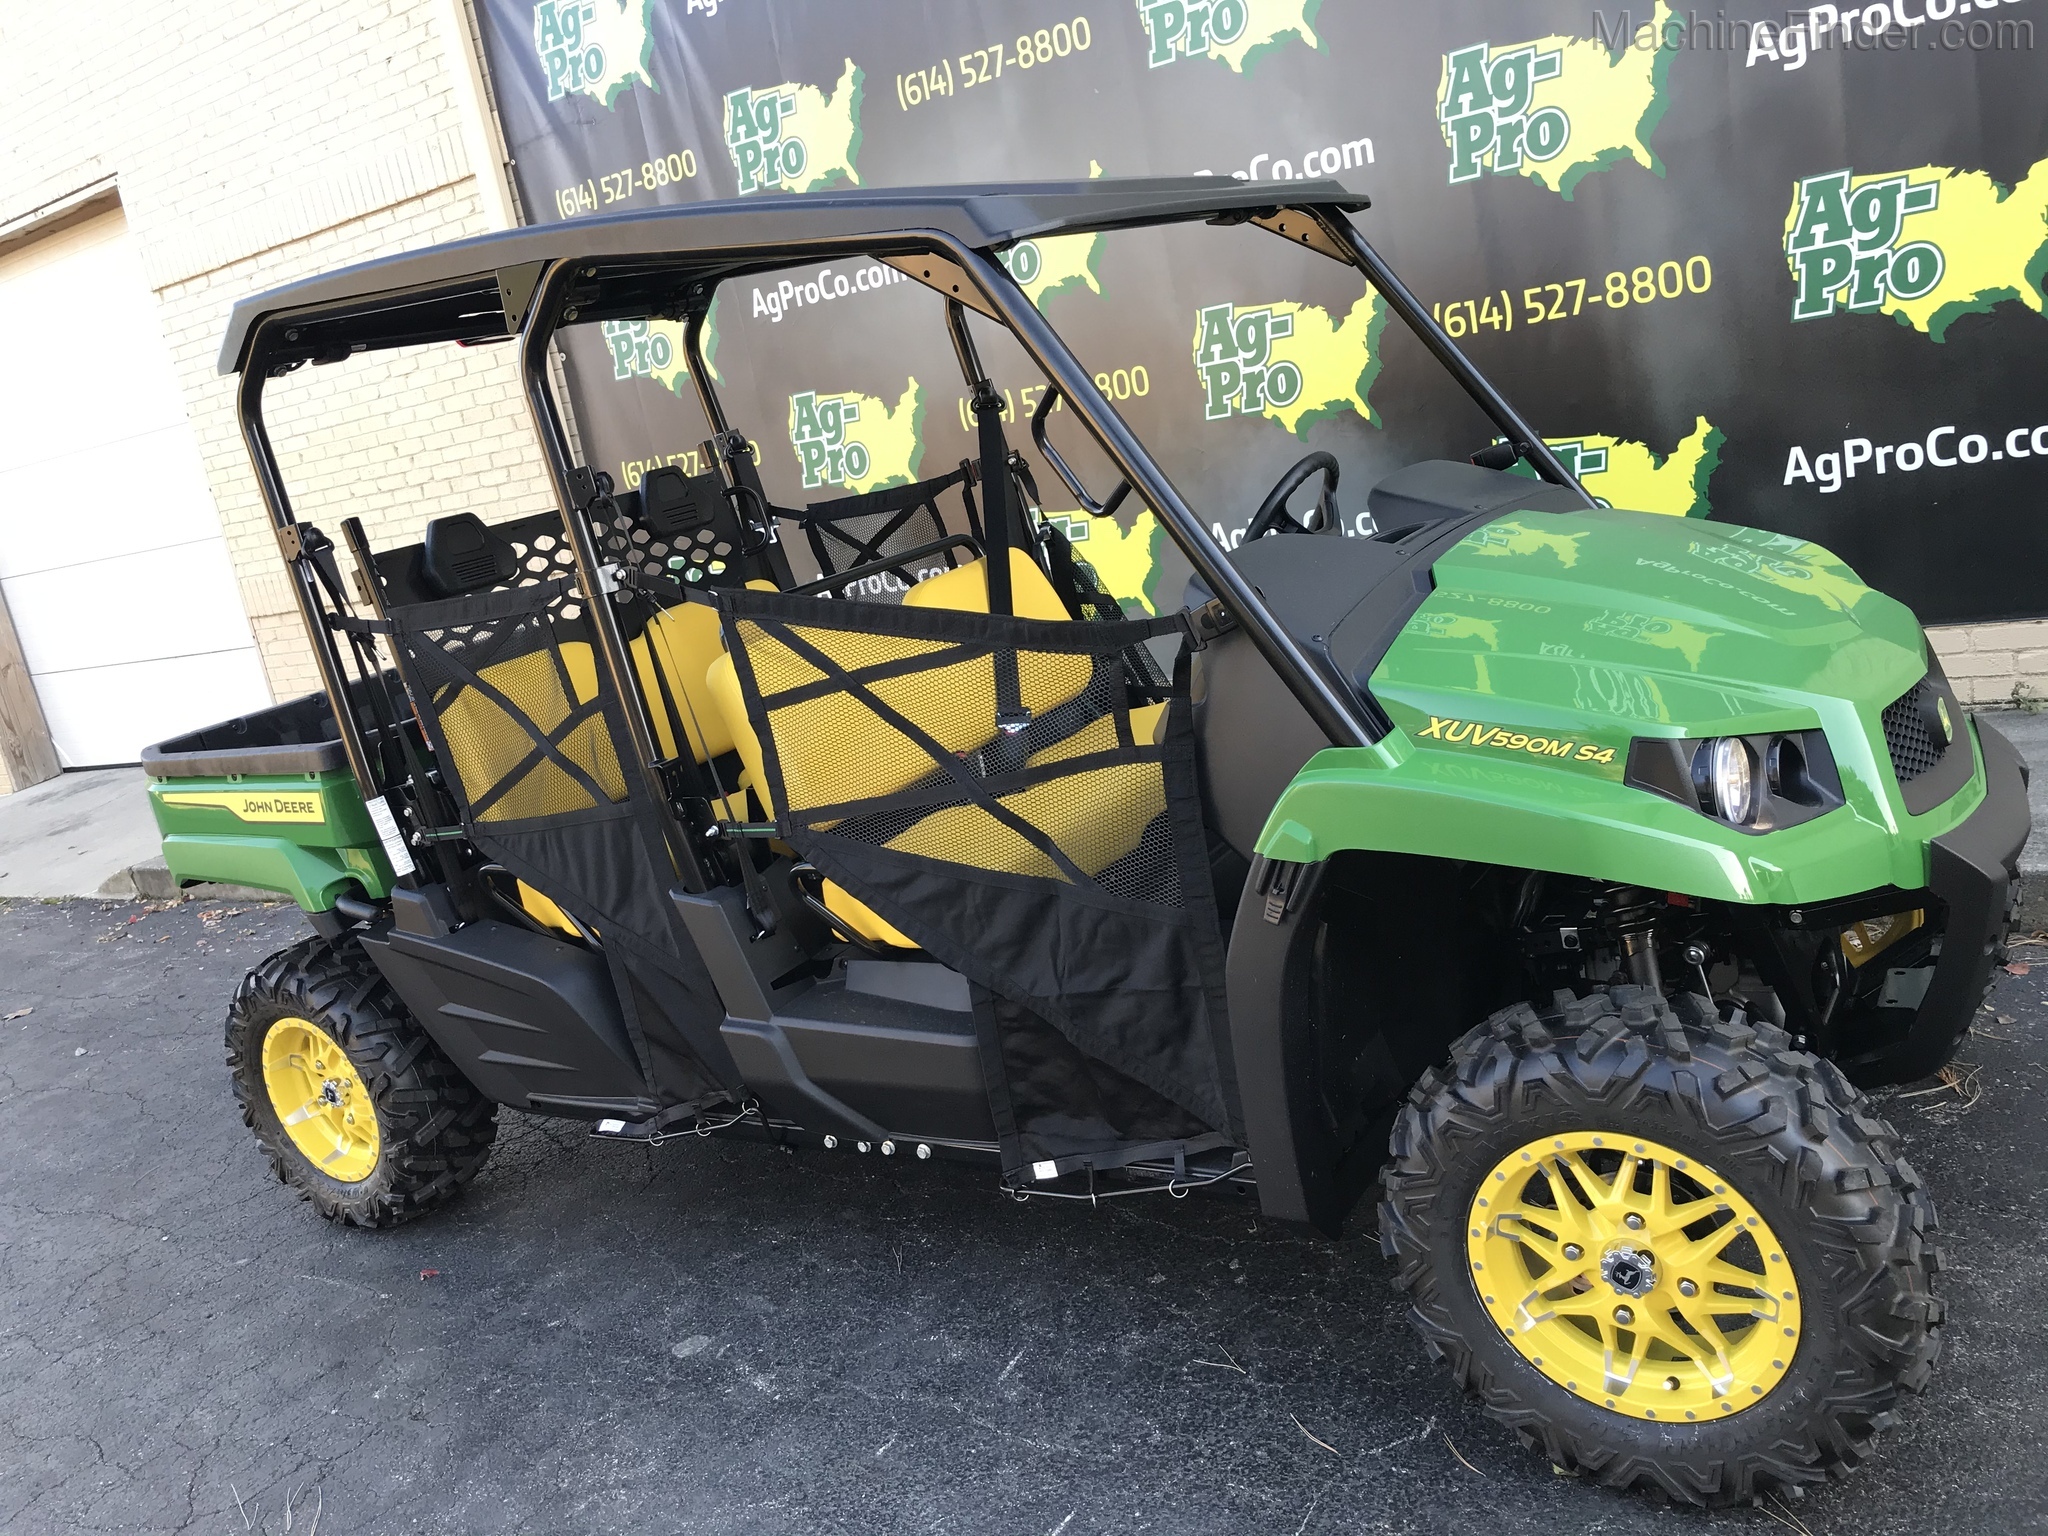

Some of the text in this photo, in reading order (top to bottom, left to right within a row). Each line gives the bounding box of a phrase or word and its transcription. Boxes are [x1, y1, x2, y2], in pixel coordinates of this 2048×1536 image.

[536, 0, 597, 52] Ag-
[1145, 0, 1247, 69] Pro
[545, 44, 606, 101] Pro
[897, 17, 1091, 111] (614) 527-8800
[1441, 42, 1563, 119] Ag-
[727, 87, 800, 144] Ag-
[1447, 105, 1570, 185] Pro
[556, 150, 697, 220] (614) 527-8800
[734, 137, 807, 196] Pro
[1788, 169, 1938, 254] Ag-
[1523, 255, 1712, 325] 527-8800
[1790, 242, 1943, 320] Pro
[609, 332, 673, 380] Pro
[1196, 302, 1294, 366] Ag-
[793, 391, 860, 446] Ag-
[1202, 360, 1301, 420] Pro
[800, 442, 870, 490] Pro
[1417, 716, 1616, 764] XUV590M S4
[243, 798, 315, 813] JOHN DEERE
